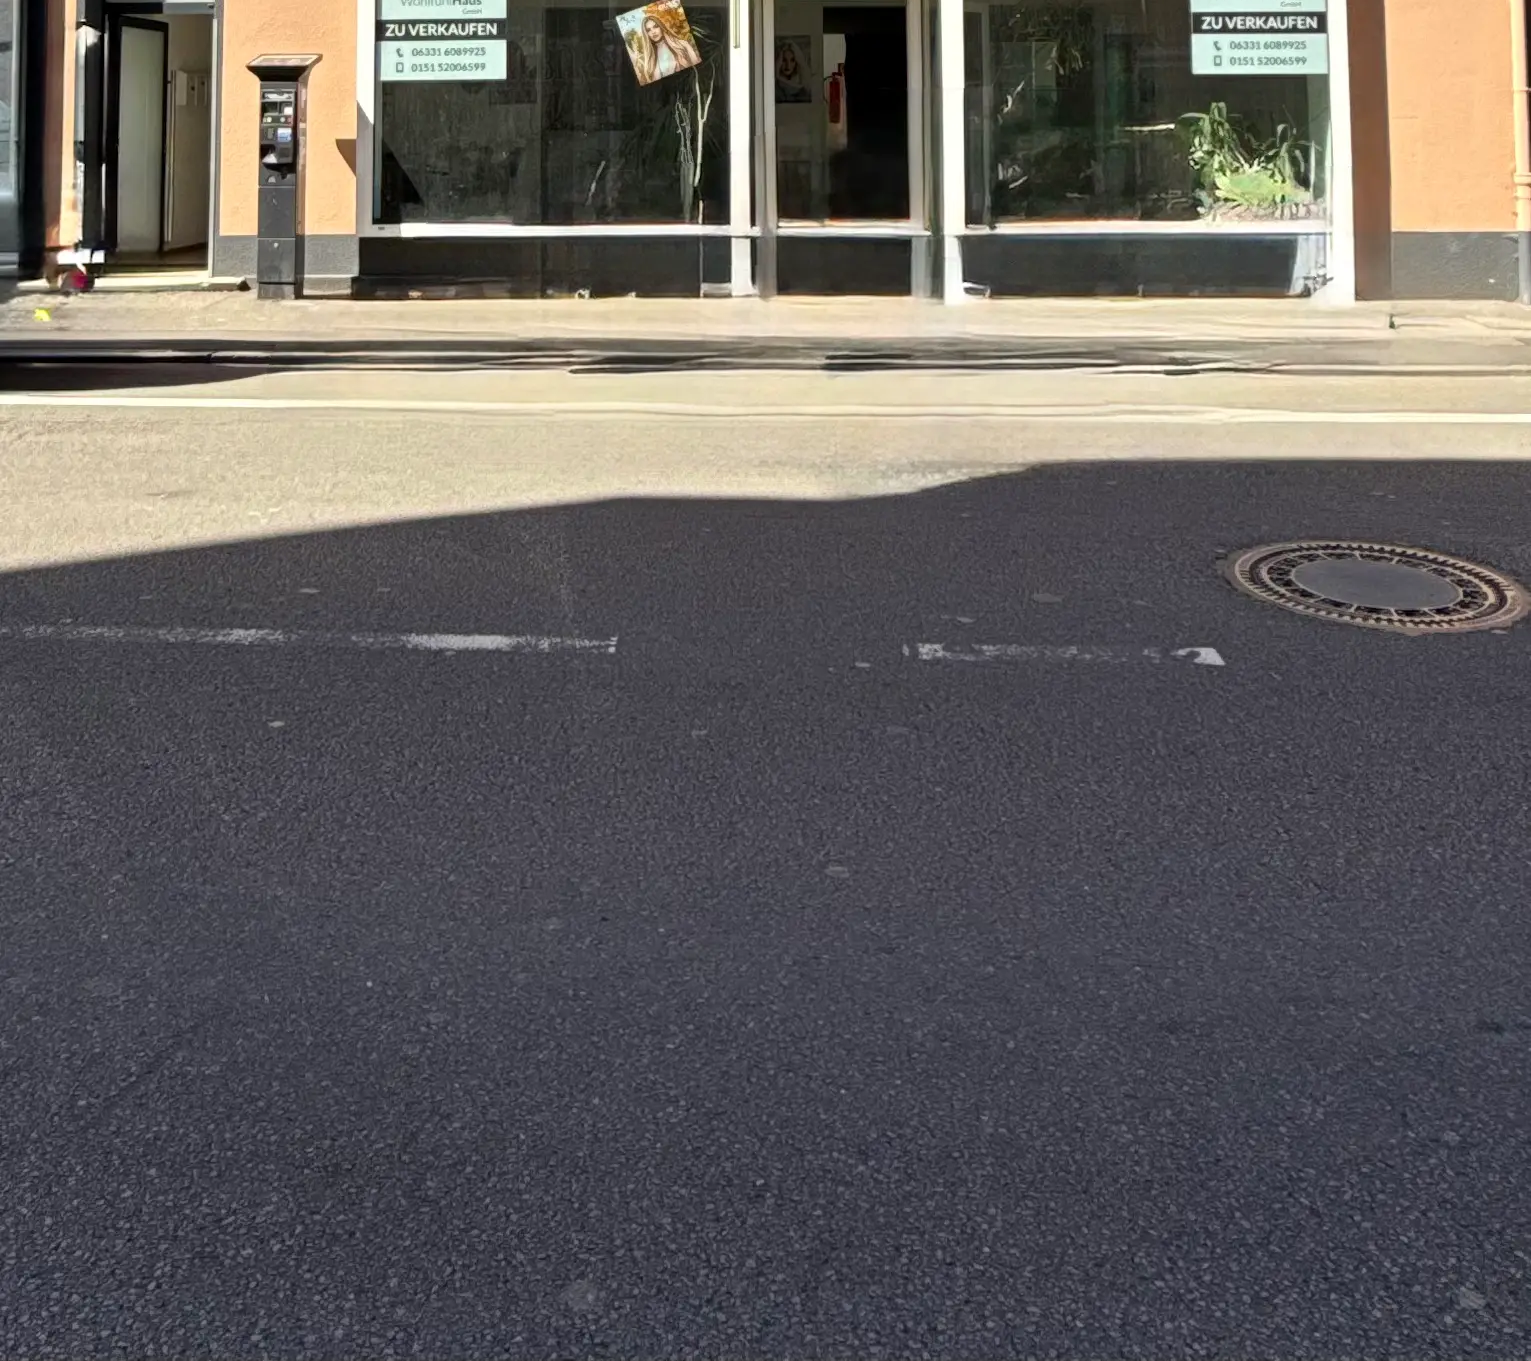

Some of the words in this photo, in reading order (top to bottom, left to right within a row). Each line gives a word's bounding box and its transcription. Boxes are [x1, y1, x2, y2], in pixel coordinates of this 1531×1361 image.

[1201, 16, 1222, 29] ZU
[1225, 15, 1318, 29] VERKAUFEN
[385, 24, 406, 37] ZU
[407, 23, 498, 37] VERKAUFEN
[1229, 41, 1260, 50] 06331
[1263, 41, 1307, 50] 6089925
[412, 48, 441, 57] 06331
[444, 47, 486, 56] 6089925
[1229, 57, 1255, 66] 0151
[1257, 56, 1307, 66] 52006599
[411, 63, 436, 72] 0151
[438, 62, 486, 72] 52006599
